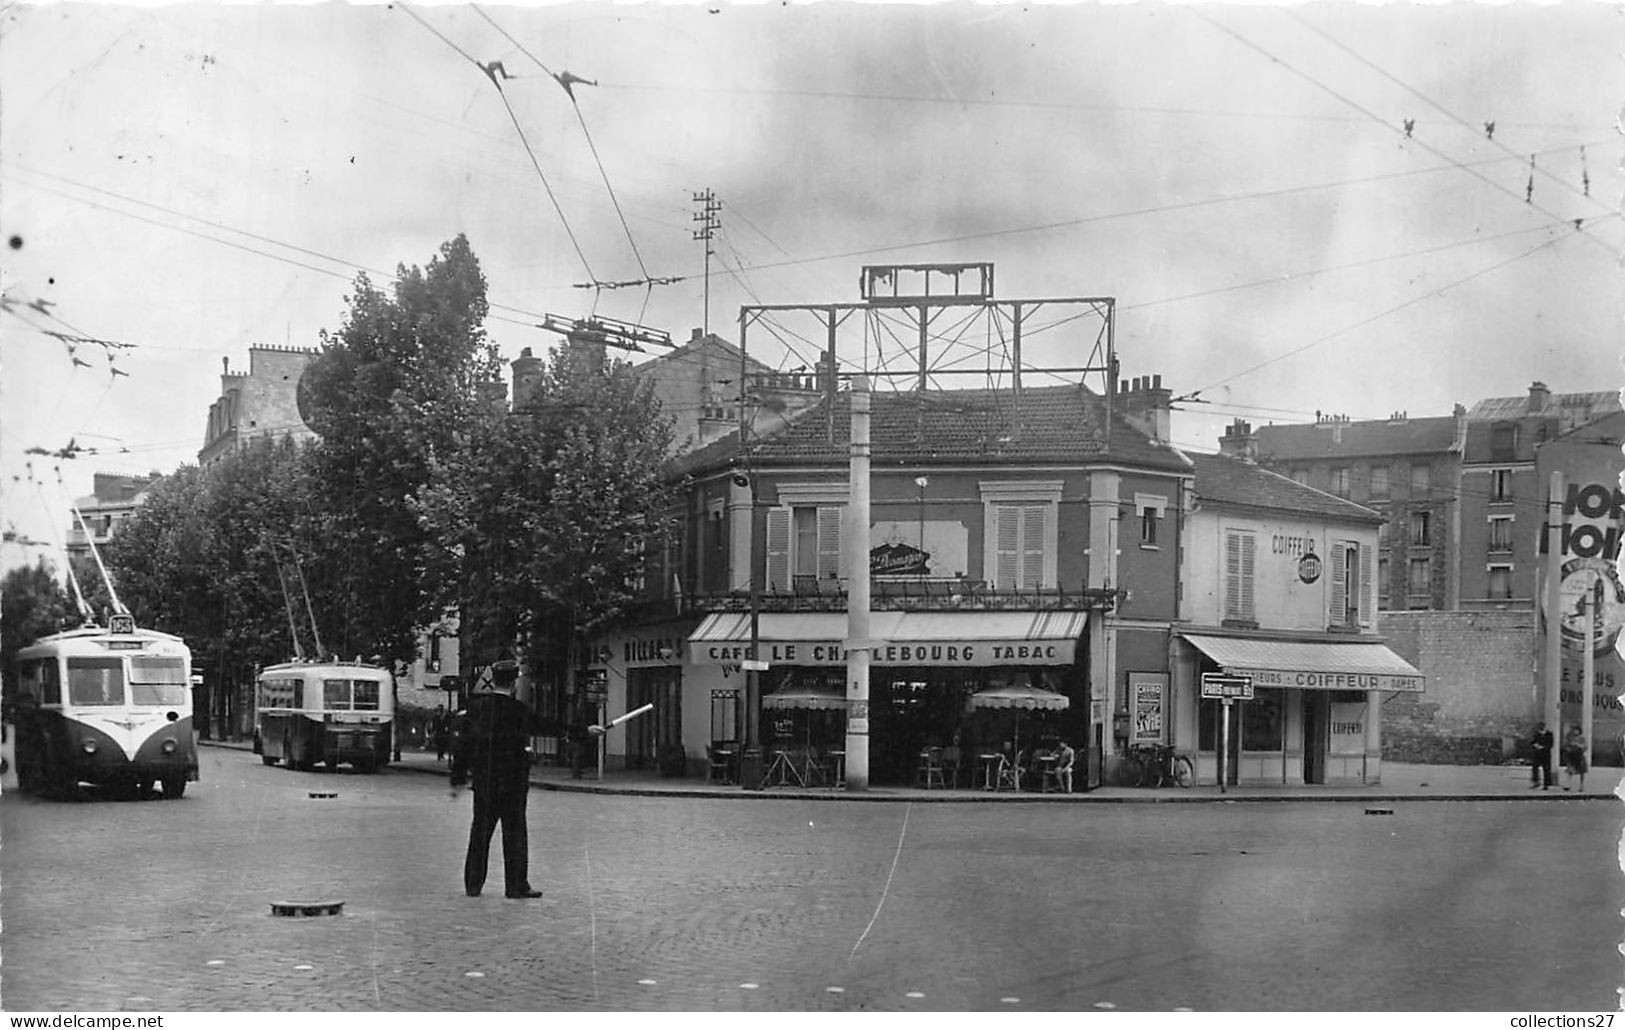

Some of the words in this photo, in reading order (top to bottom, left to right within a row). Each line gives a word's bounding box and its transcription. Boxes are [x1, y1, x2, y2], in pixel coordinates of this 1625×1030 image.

[772, 646, 795, 661] LE
[992, 646, 1056, 659] TABAC
[1295, 673, 1379, 689] COIFFEUR
